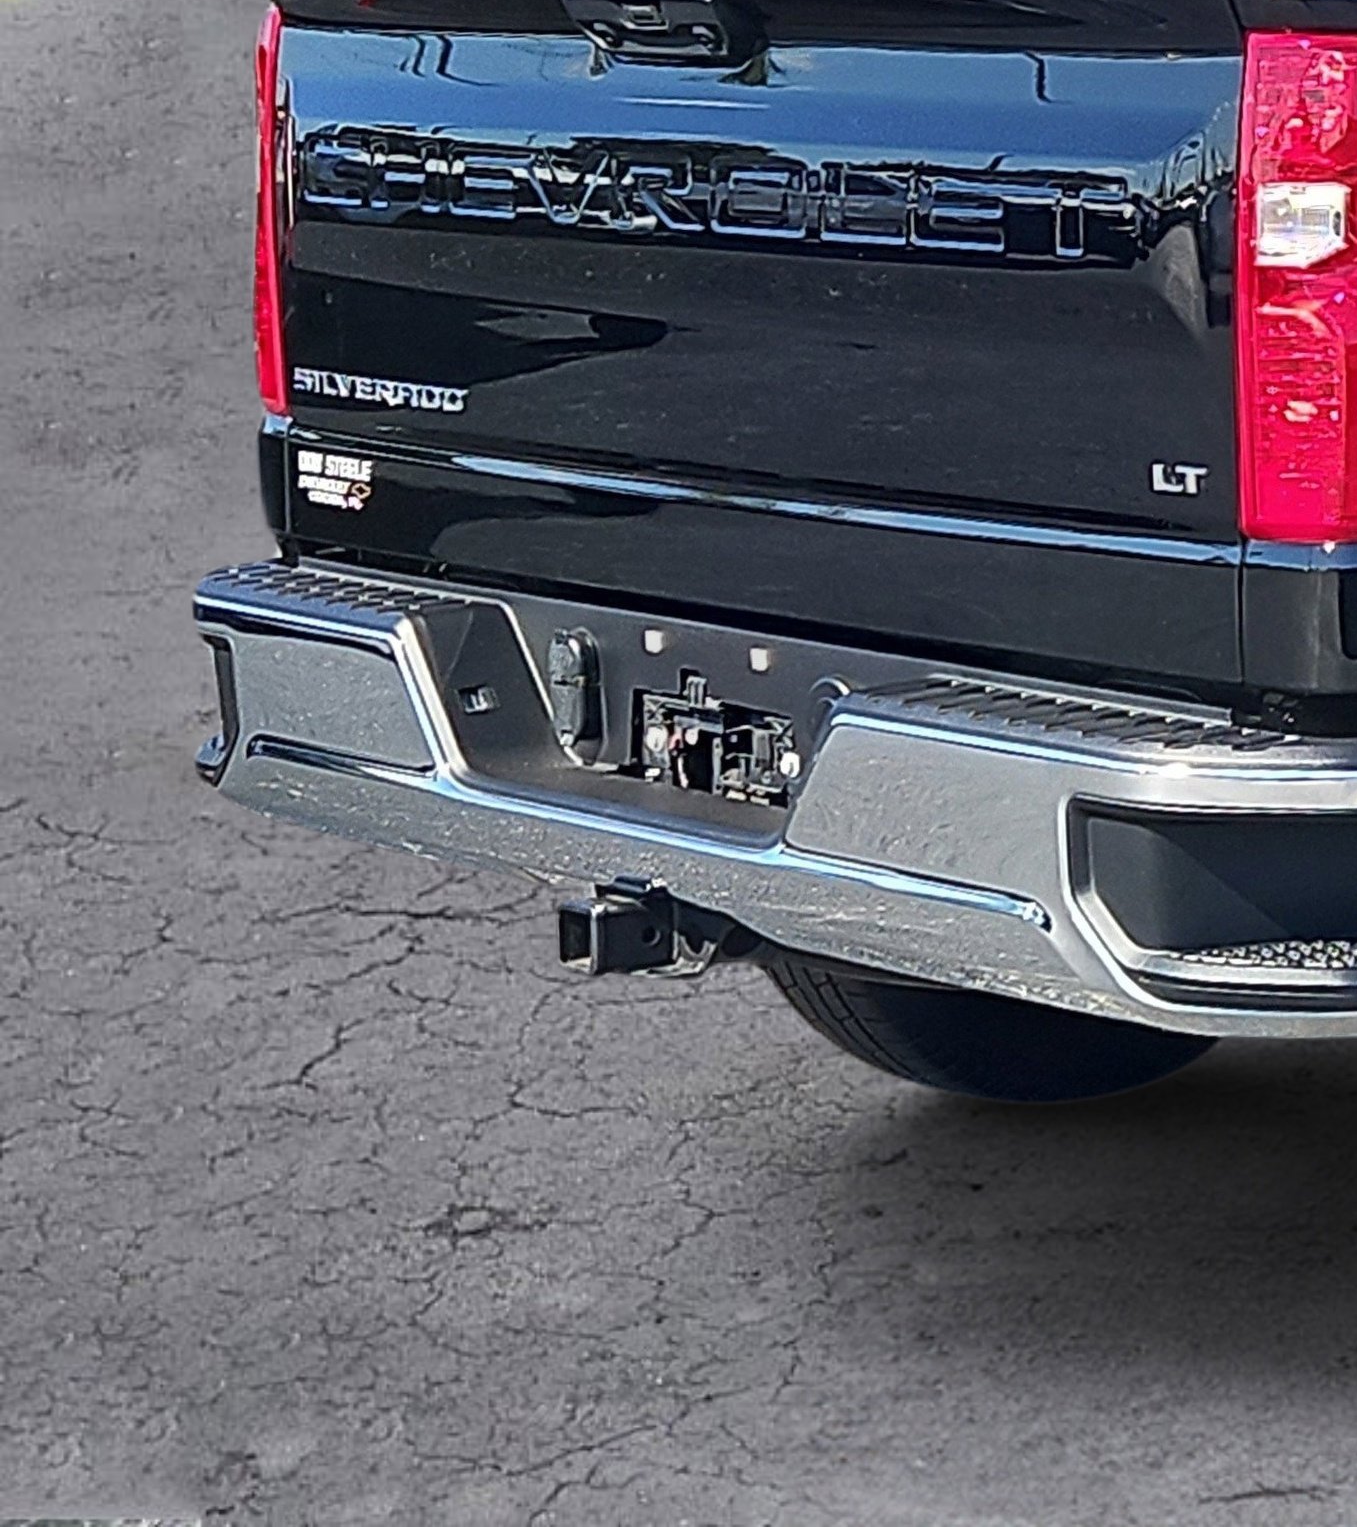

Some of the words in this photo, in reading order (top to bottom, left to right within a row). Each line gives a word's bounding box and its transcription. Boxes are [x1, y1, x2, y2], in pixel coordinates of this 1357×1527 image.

[303, 130, 1130, 258] CHEVROLET
[293, 367, 468, 412] SILVERADO
[1152, 463, 1208, 495] LT
